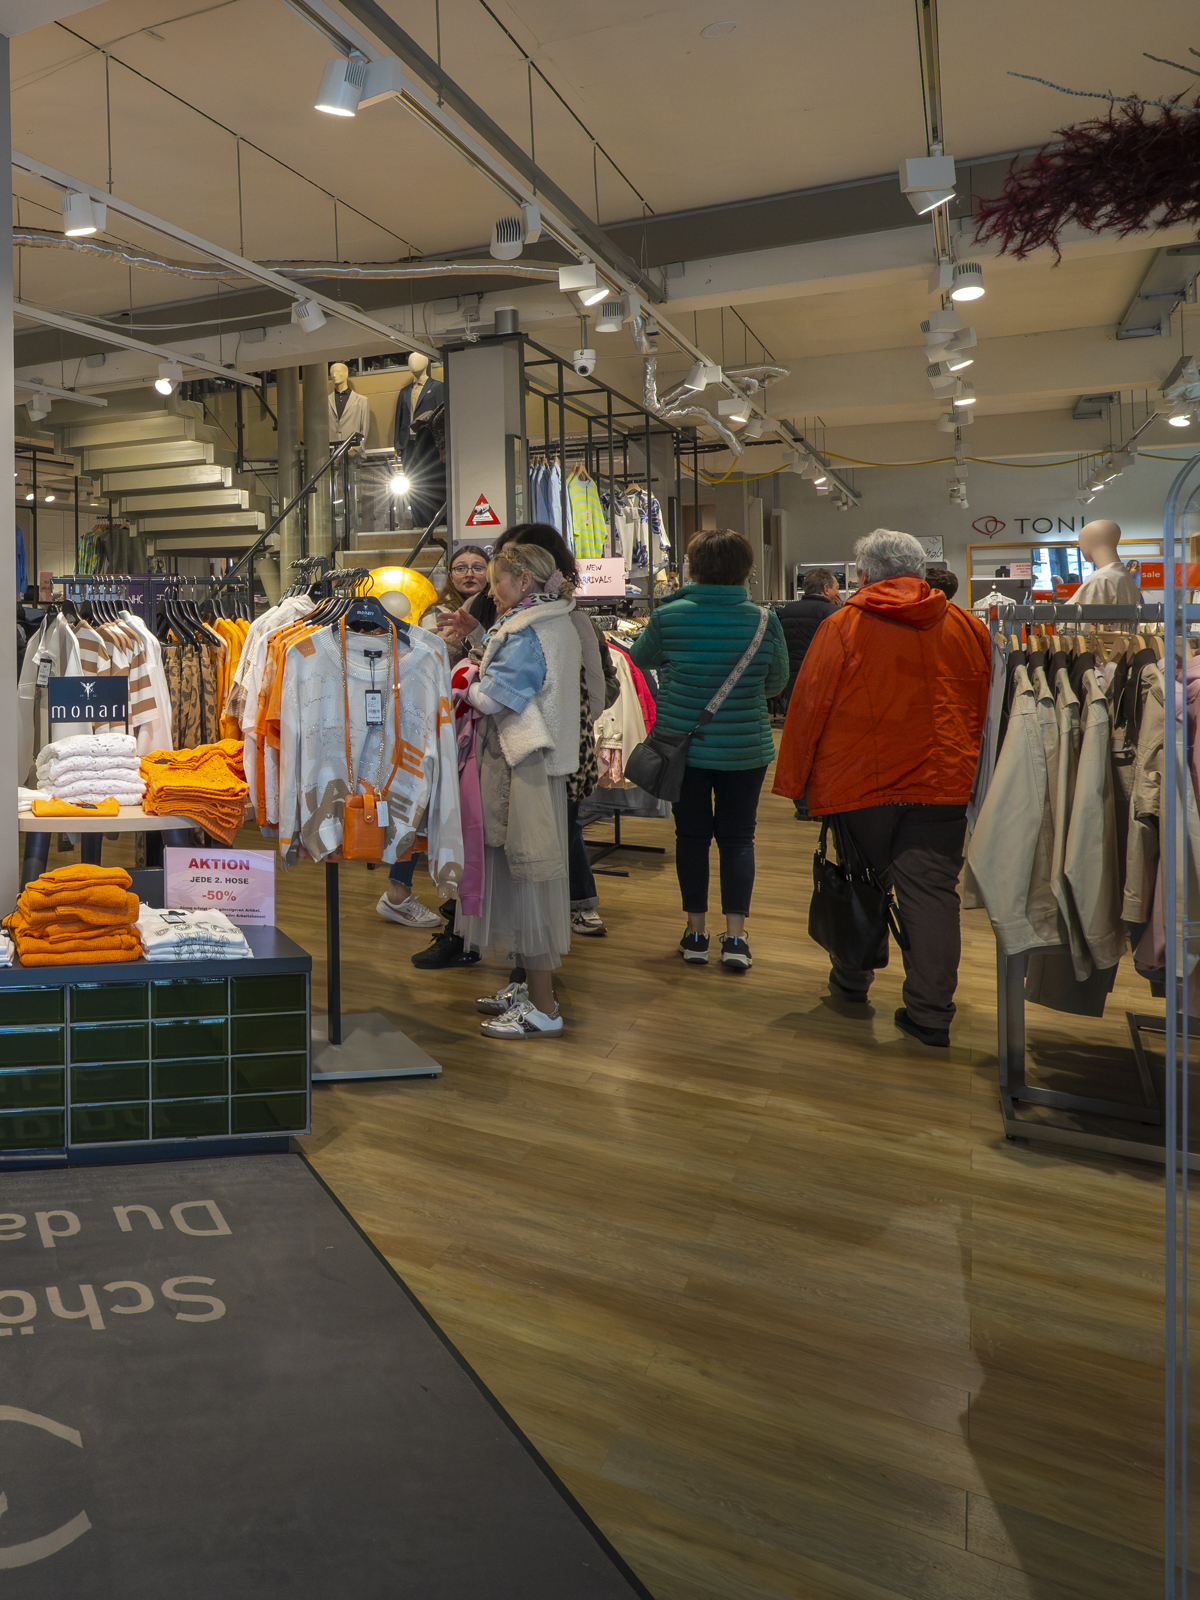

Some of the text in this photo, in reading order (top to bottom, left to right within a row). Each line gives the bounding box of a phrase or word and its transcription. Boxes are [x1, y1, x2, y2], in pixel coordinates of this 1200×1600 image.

[1014, 516, 1085, 534] TONI
[1141, 570, 1161, 578] sale
[51, 704, 126, 718] monari
[188, 857, 250, 871] AKTION
[190, 876, 213, 884] JEDE
[225, 877, 250, 885] HOSE
[202, 890, 237, 902] -50%
[112, 1199, 233, 1236] Du
